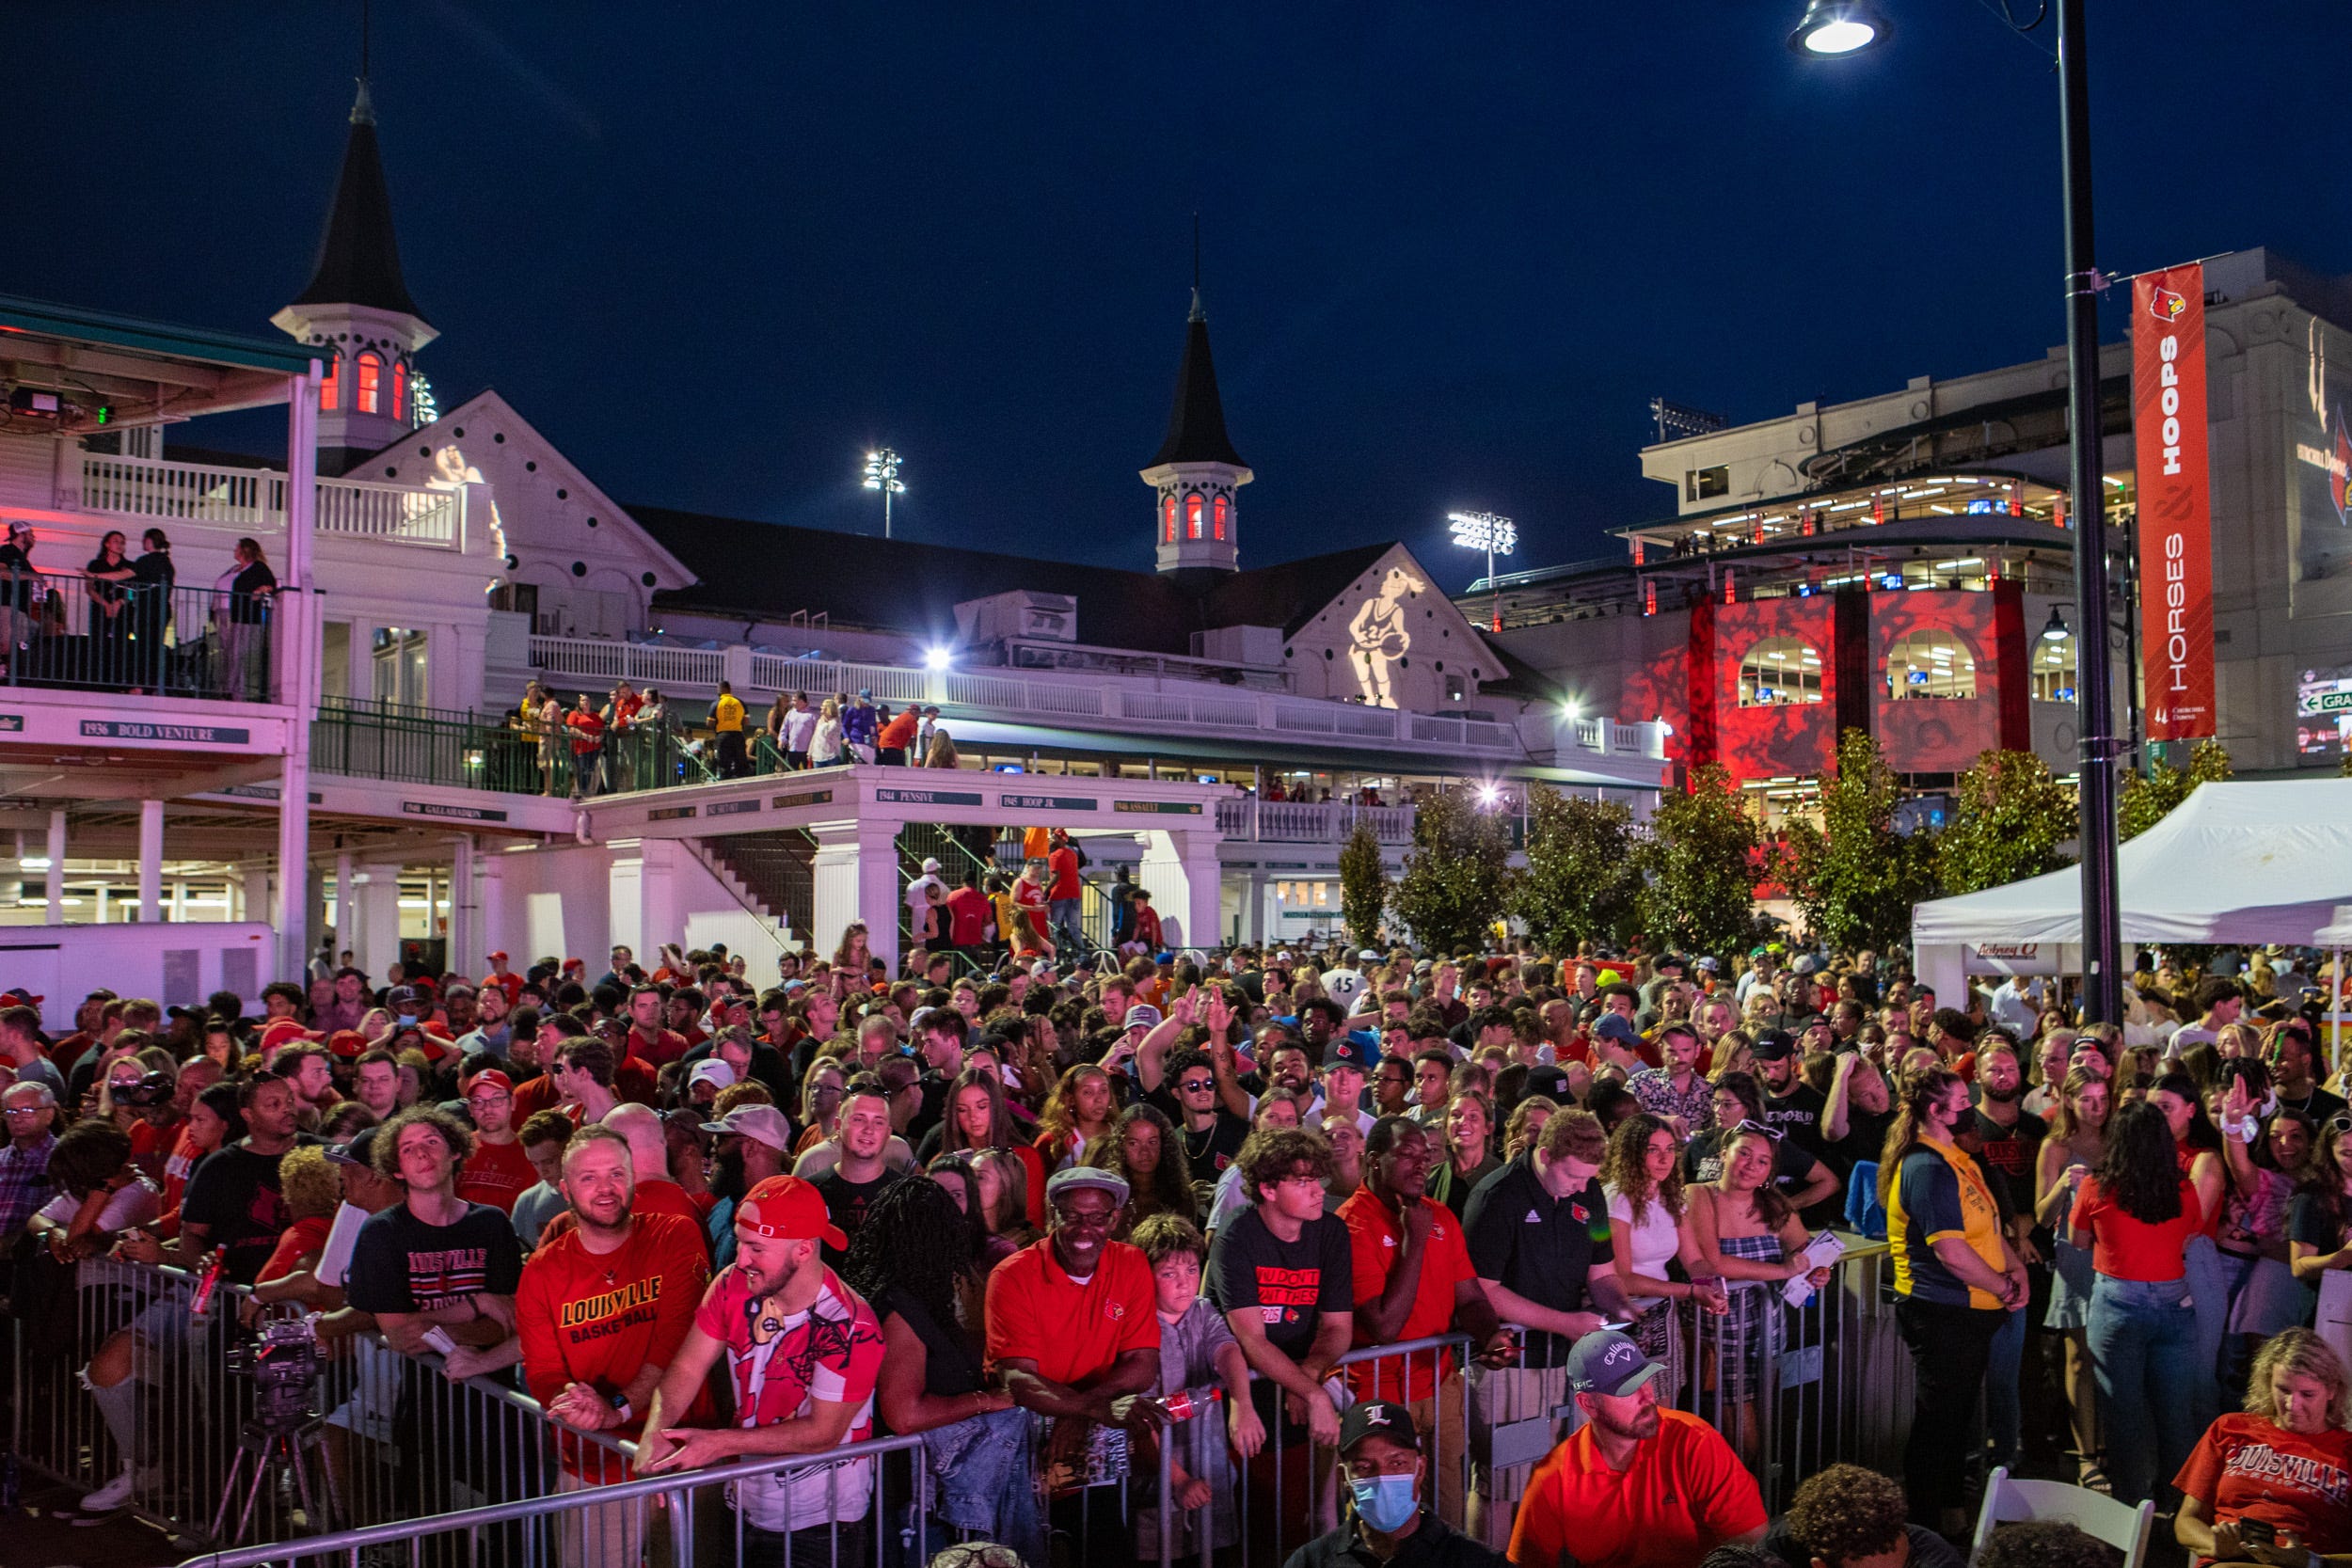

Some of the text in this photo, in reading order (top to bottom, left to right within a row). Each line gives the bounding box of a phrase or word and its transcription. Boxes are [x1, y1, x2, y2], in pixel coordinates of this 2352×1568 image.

[2160, 335, 2181, 476] HOOPS
[2165, 532, 2188, 691] HORSES
[84, 723, 215, 741] 1936 BOLD VENTURE
[880, 790, 934, 802] 1944 PENSIVE
[1004, 797, 1017, 806] 1945
[1022, 798, 1042, 807] HOOP
[1130, 802, 1158, 812] ASSAULT
[1978, 943, 2018, 957] Aubrey
[1333, 977, 1353, 993] 45
[407, 1248, 487, 1273] LUISVILLE
[560, 1275, 662, 1328] LOUISVLLE
[569, 1307, 658, 1344] BASKEBALL
[1604, 1341, 1636, 1366] Callaway
